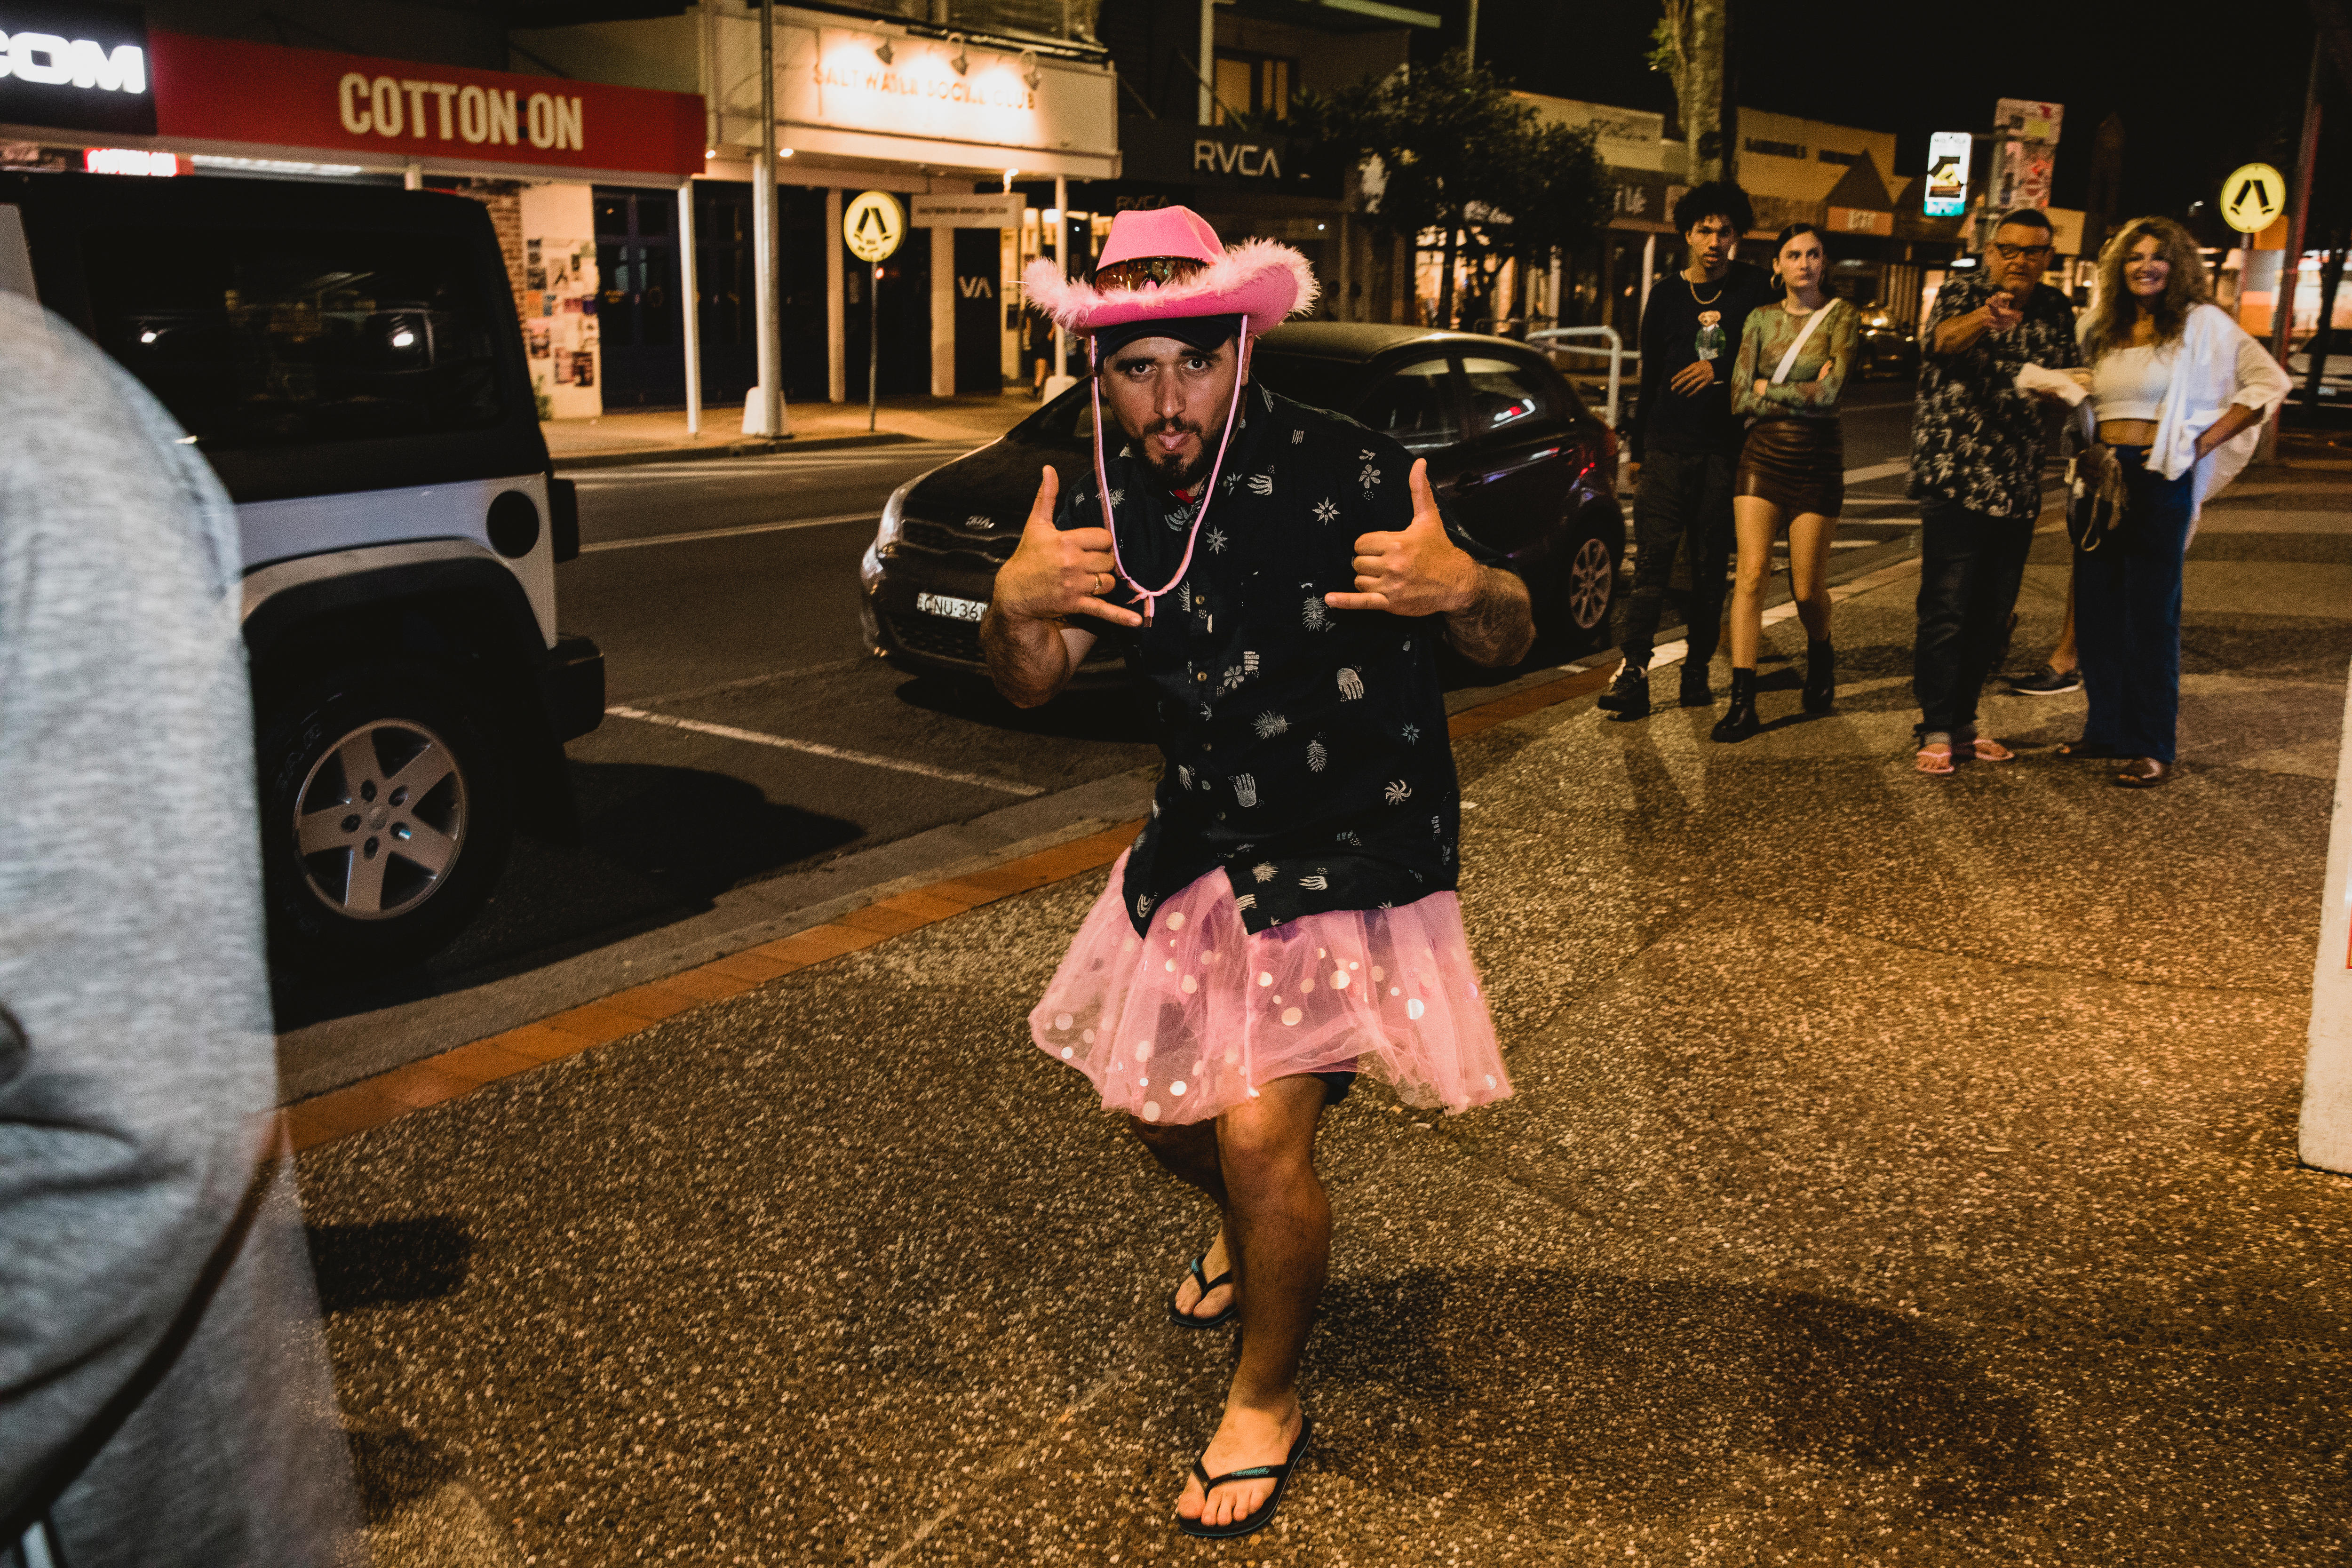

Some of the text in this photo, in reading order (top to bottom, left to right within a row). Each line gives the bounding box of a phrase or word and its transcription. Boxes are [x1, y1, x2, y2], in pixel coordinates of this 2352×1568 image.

[339, 72, 583, 151] COTTON ON
[1194, 140, 1281, 178] RVCA
